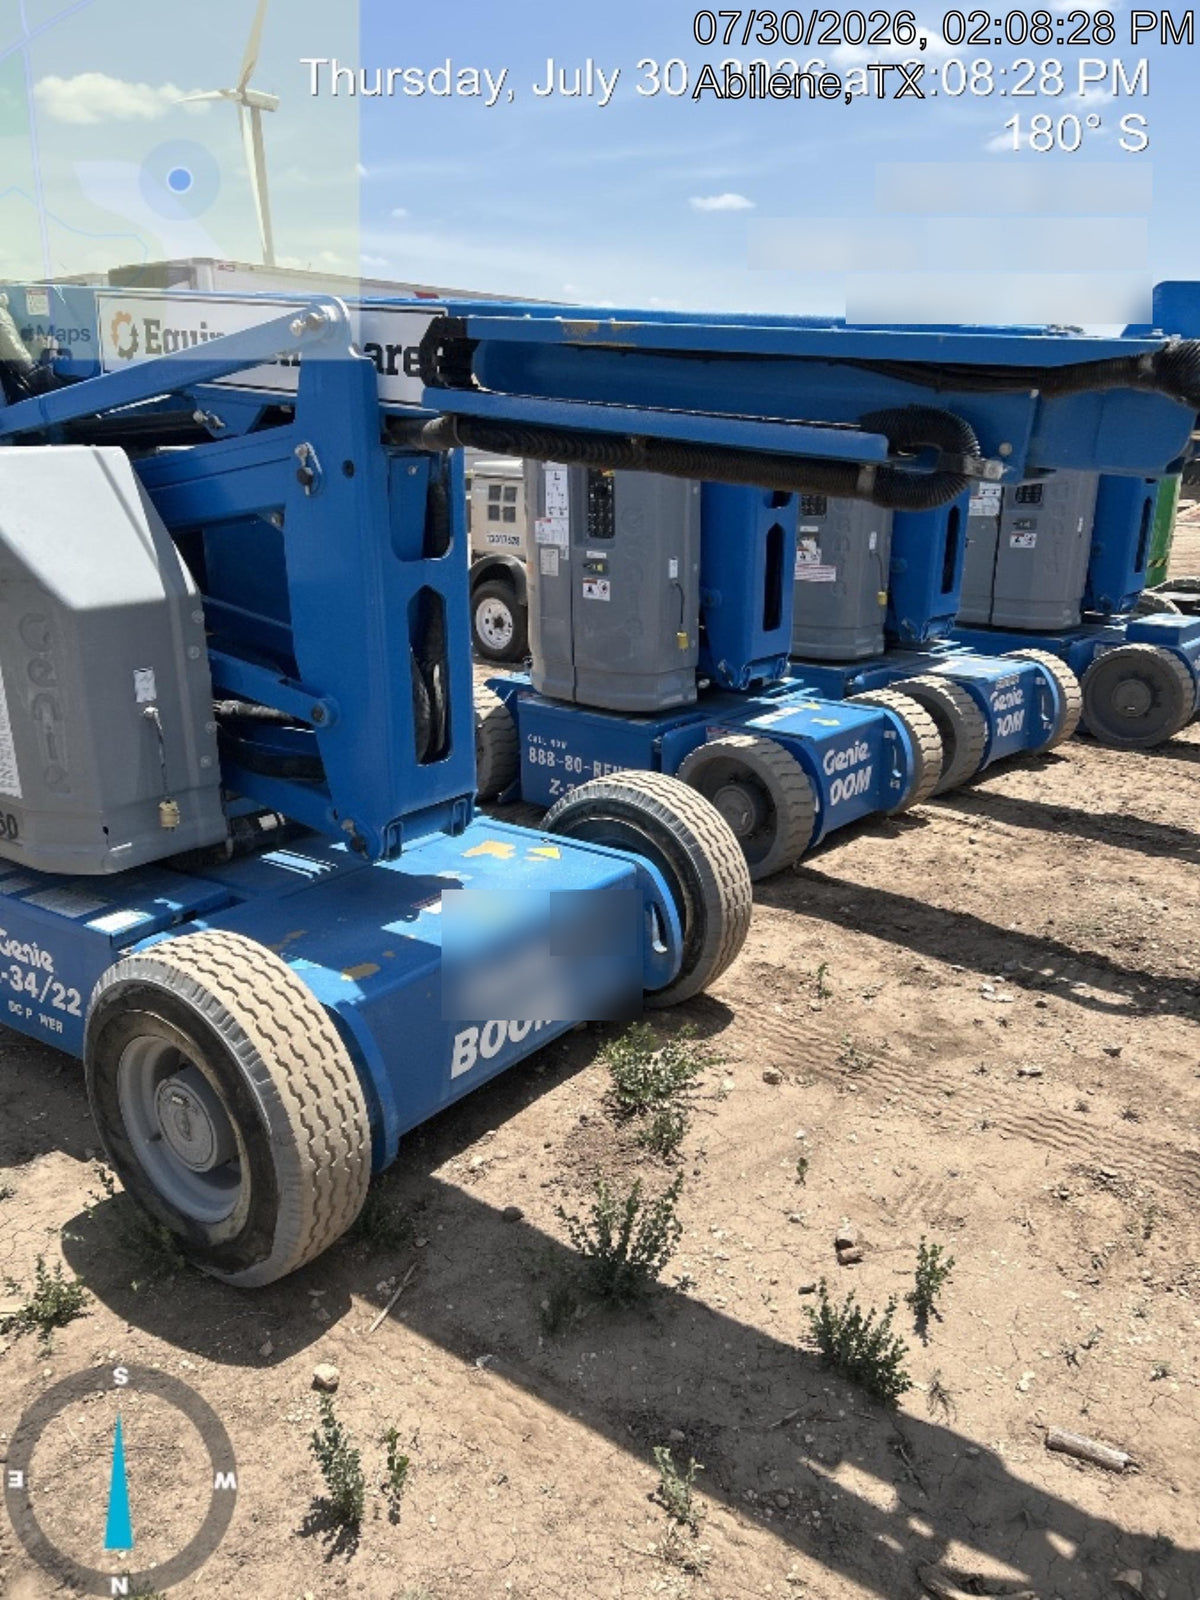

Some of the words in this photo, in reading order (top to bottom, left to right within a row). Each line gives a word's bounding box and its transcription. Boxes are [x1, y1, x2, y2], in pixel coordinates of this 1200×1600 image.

[822, 740, 871, 776] Genie
[0, 927, 55, 973] Genie
[0, 964, 82, 1018] -34/22
[25, 1007, 63, 1034] PWER
[450, 1019, 552, 1080] BOO
